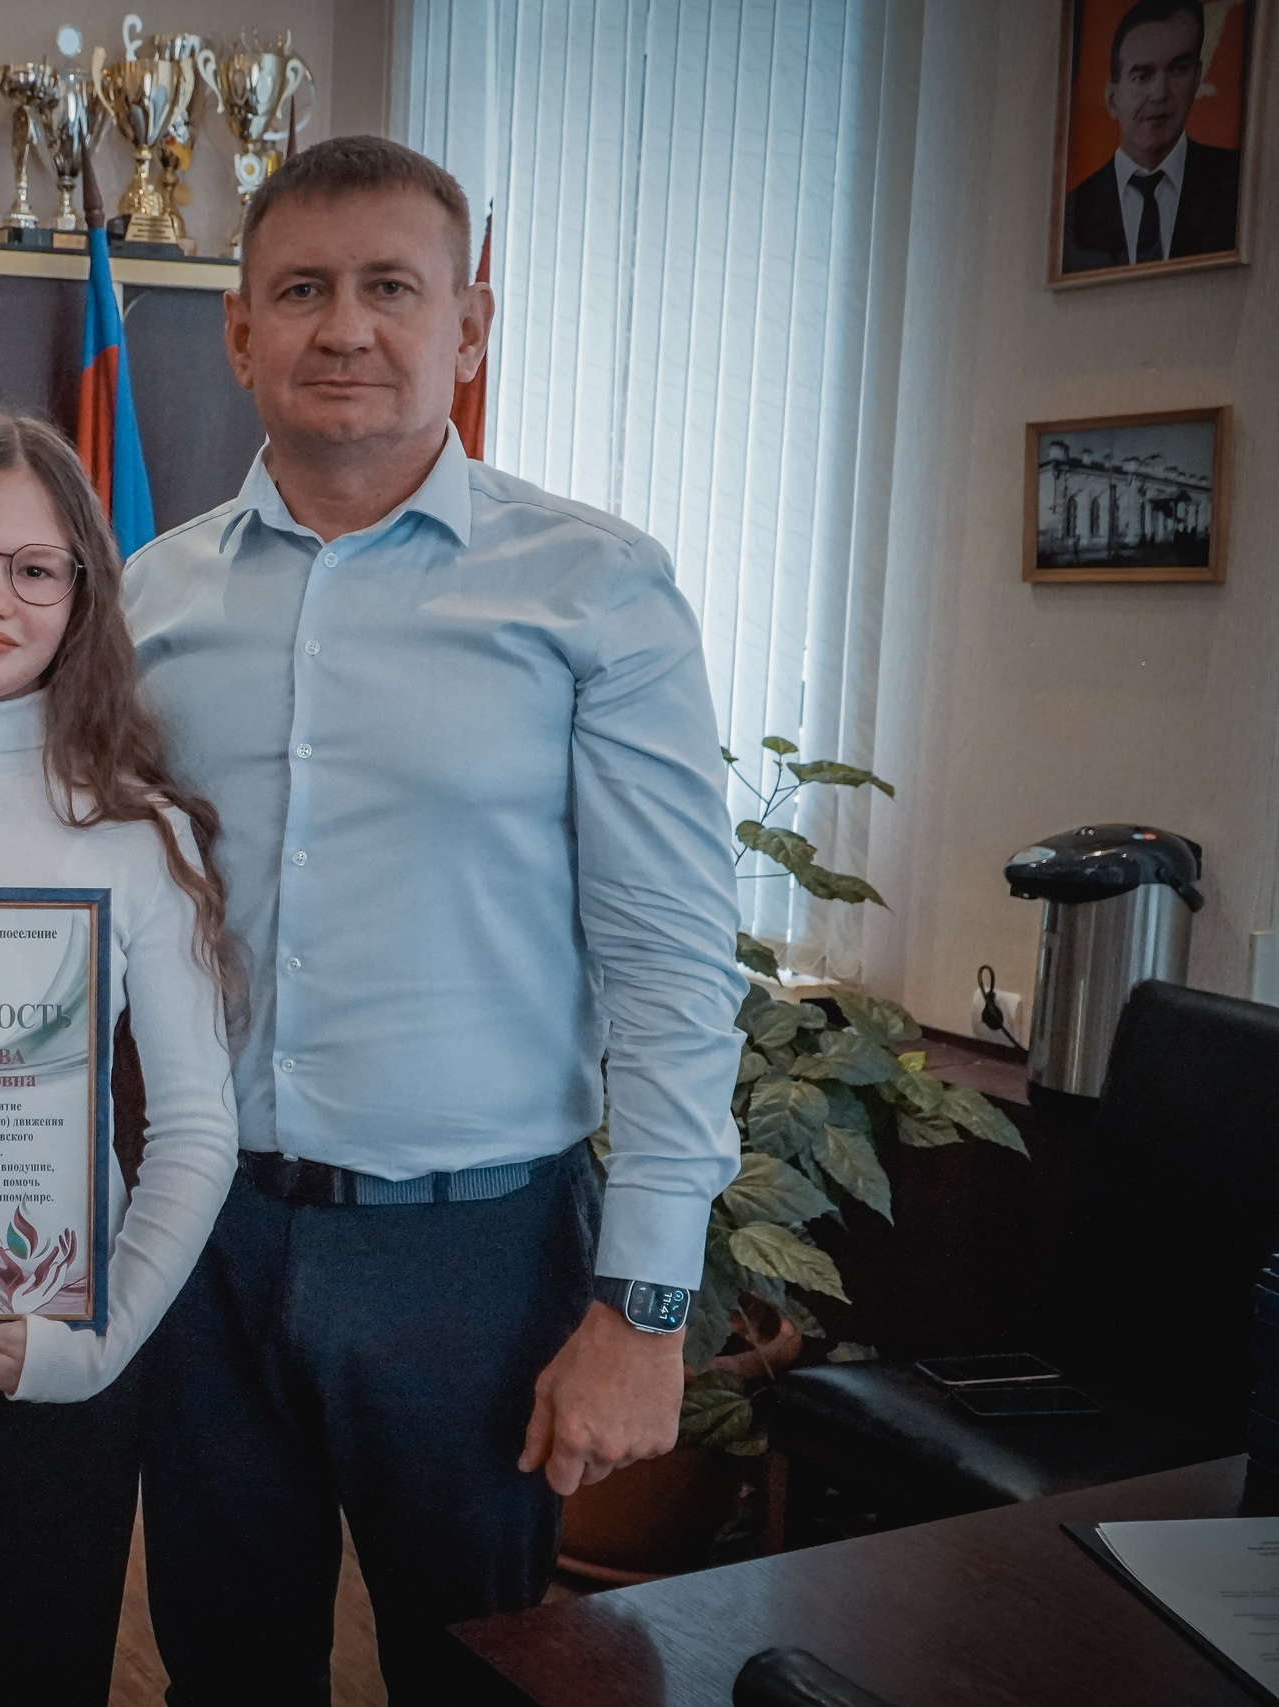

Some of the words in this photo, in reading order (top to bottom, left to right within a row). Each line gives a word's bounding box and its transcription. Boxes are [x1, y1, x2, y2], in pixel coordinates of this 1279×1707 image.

[0, 929, 57, 939] поселение
[13, 1117, 63, 1128] движения
[3, 1178, 40, 1188] помочь
[26, 1193, 54, 1205] мире.
